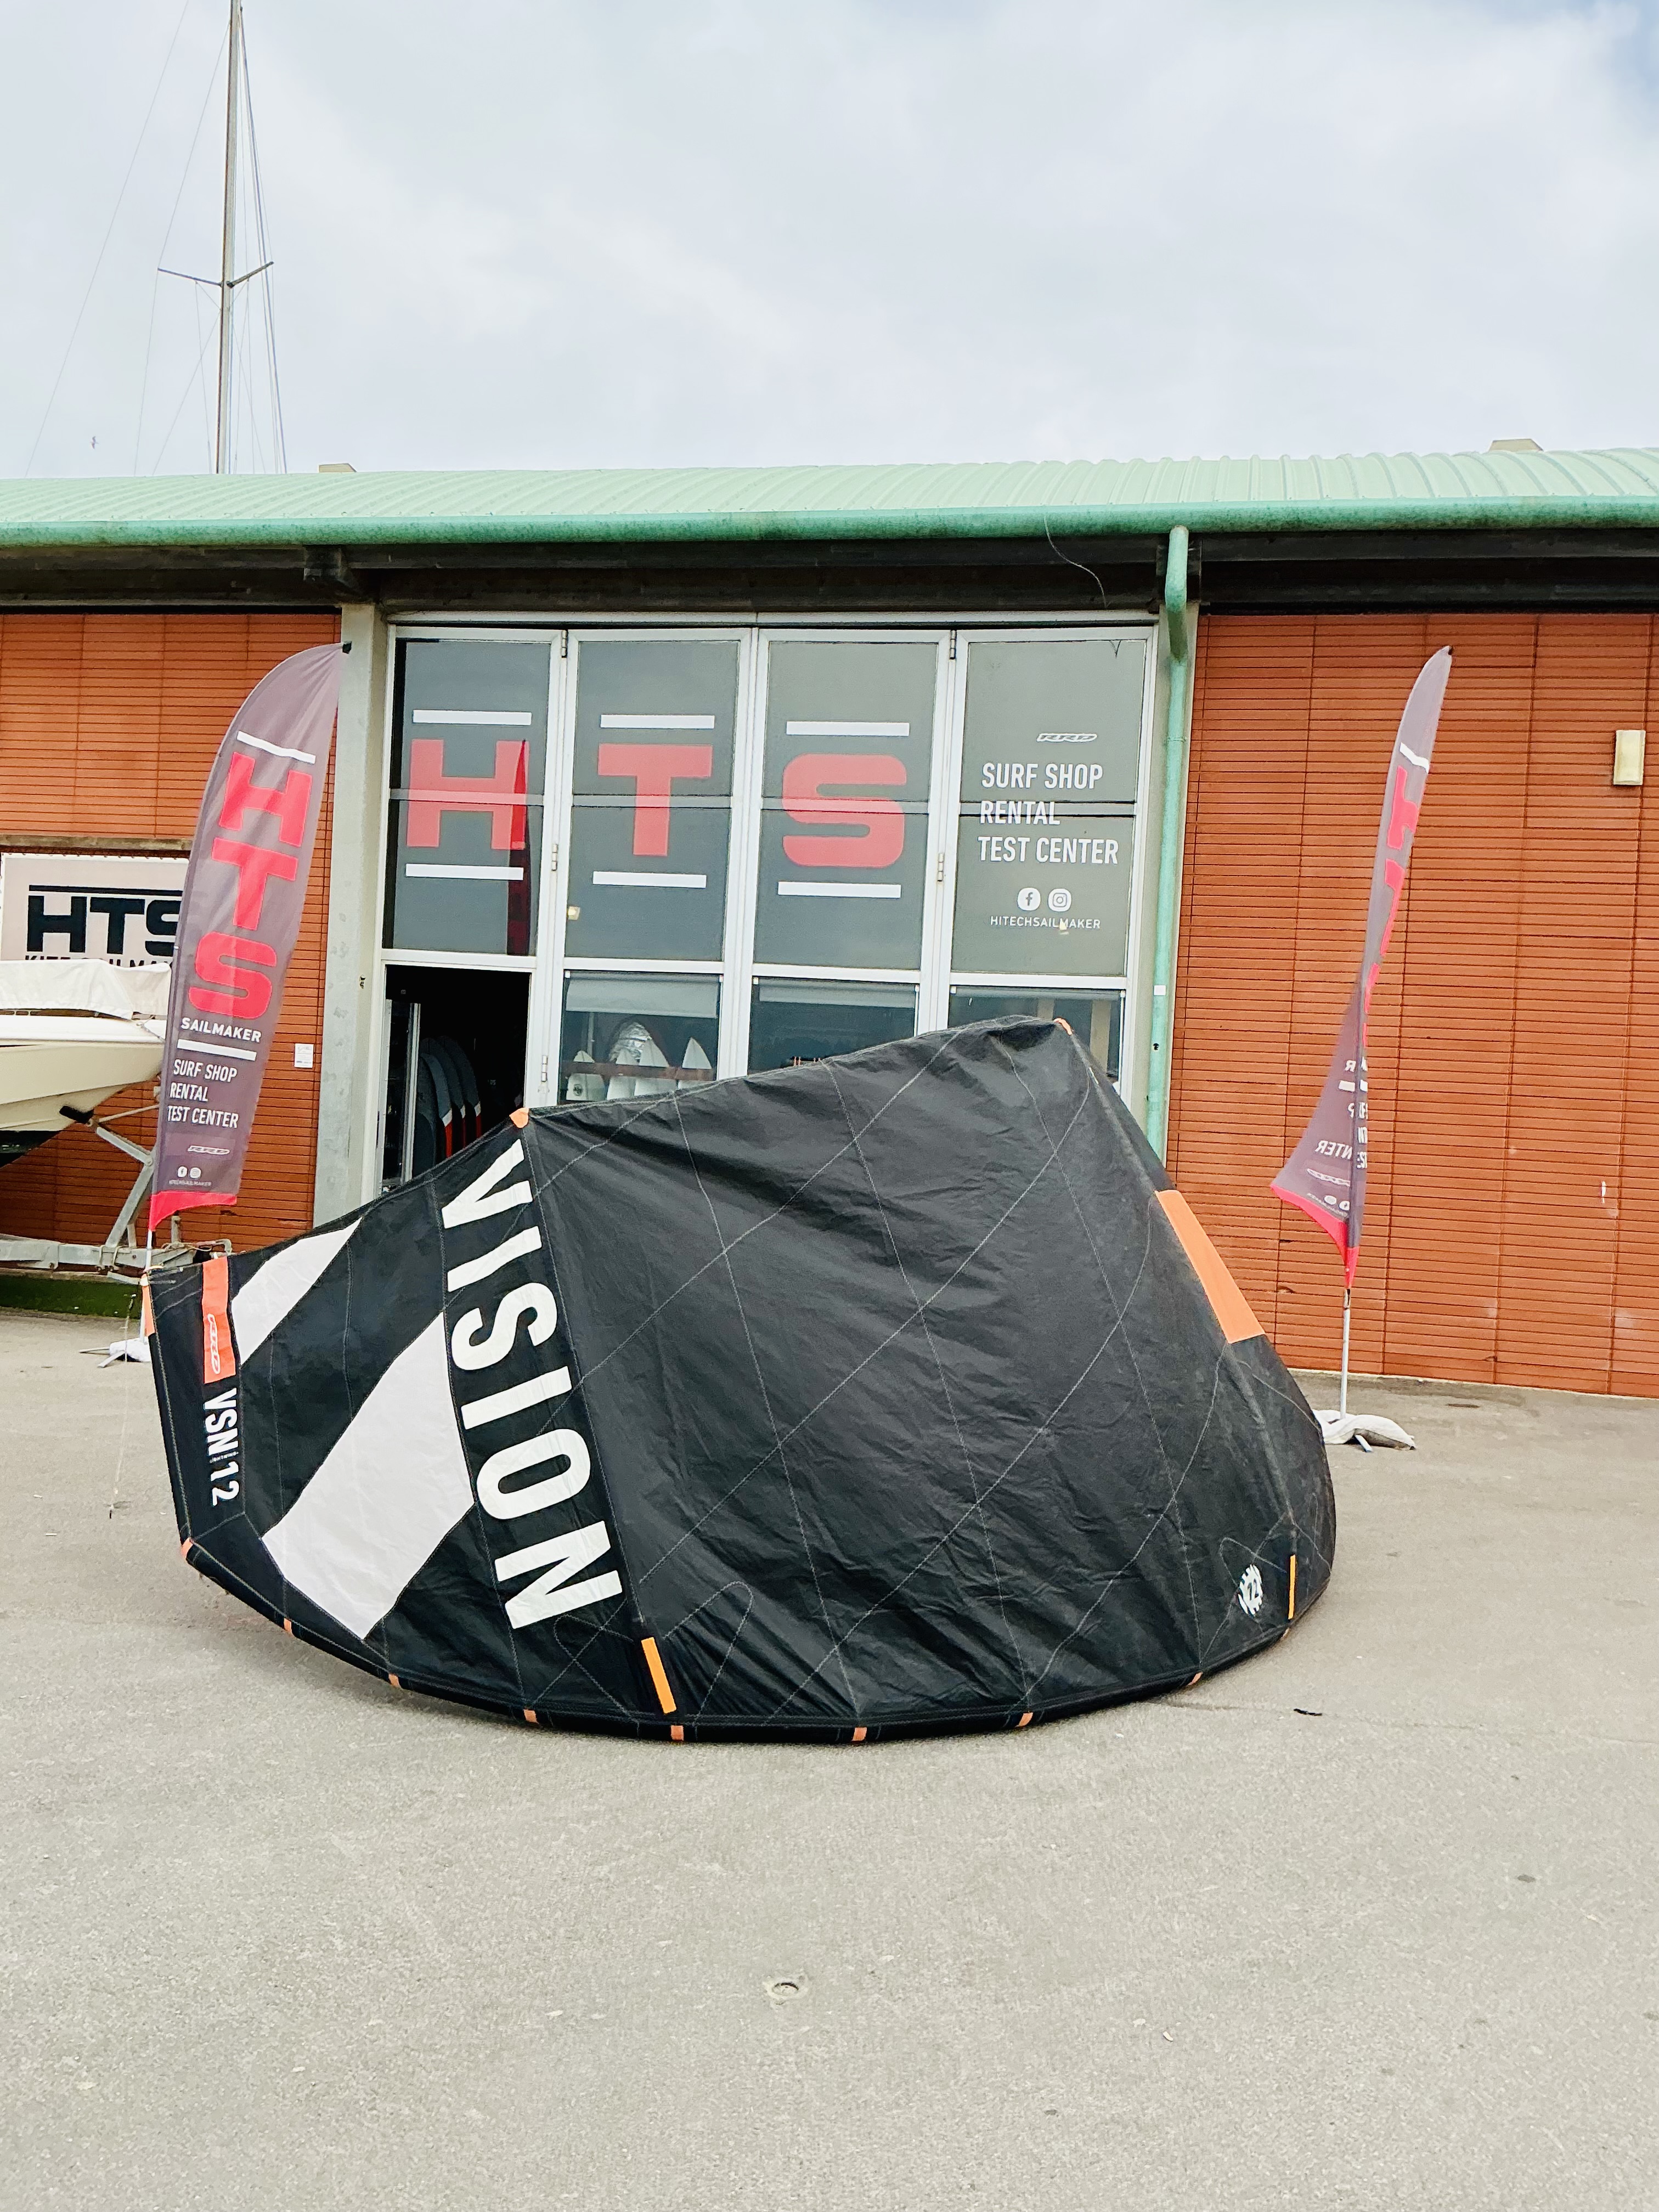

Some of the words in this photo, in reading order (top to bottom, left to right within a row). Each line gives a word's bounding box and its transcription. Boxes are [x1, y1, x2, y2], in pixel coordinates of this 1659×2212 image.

[981, 763, 1039, 788] SURF
[1044, 763, 1103, 789] SHOP
[980, 800, 1060, 825] RENTAL
[978, 837, 1030, 862] TEST
[1036, 837, 1119, 864] CENTER
[188, 752, 313, 1019] HTS
[990, 916, 1101, 929] HITECHSAILMAKER
[180, 1017, 262, 1042] SAILMAKER
[173, 1058, 203, 1077] SURF
[204, 1064, 238, 1082] SHOP
[170, 1082, 208, 1102] RENTAL
[167, 1105, 190, 1122] TEST
[191, 1108, 239, 1128] CENTER
[441, 1138, 623, 1629] VISION
[202, 1387, 239, 1457] VSN
[210, 1461, 240, 1506] 12
